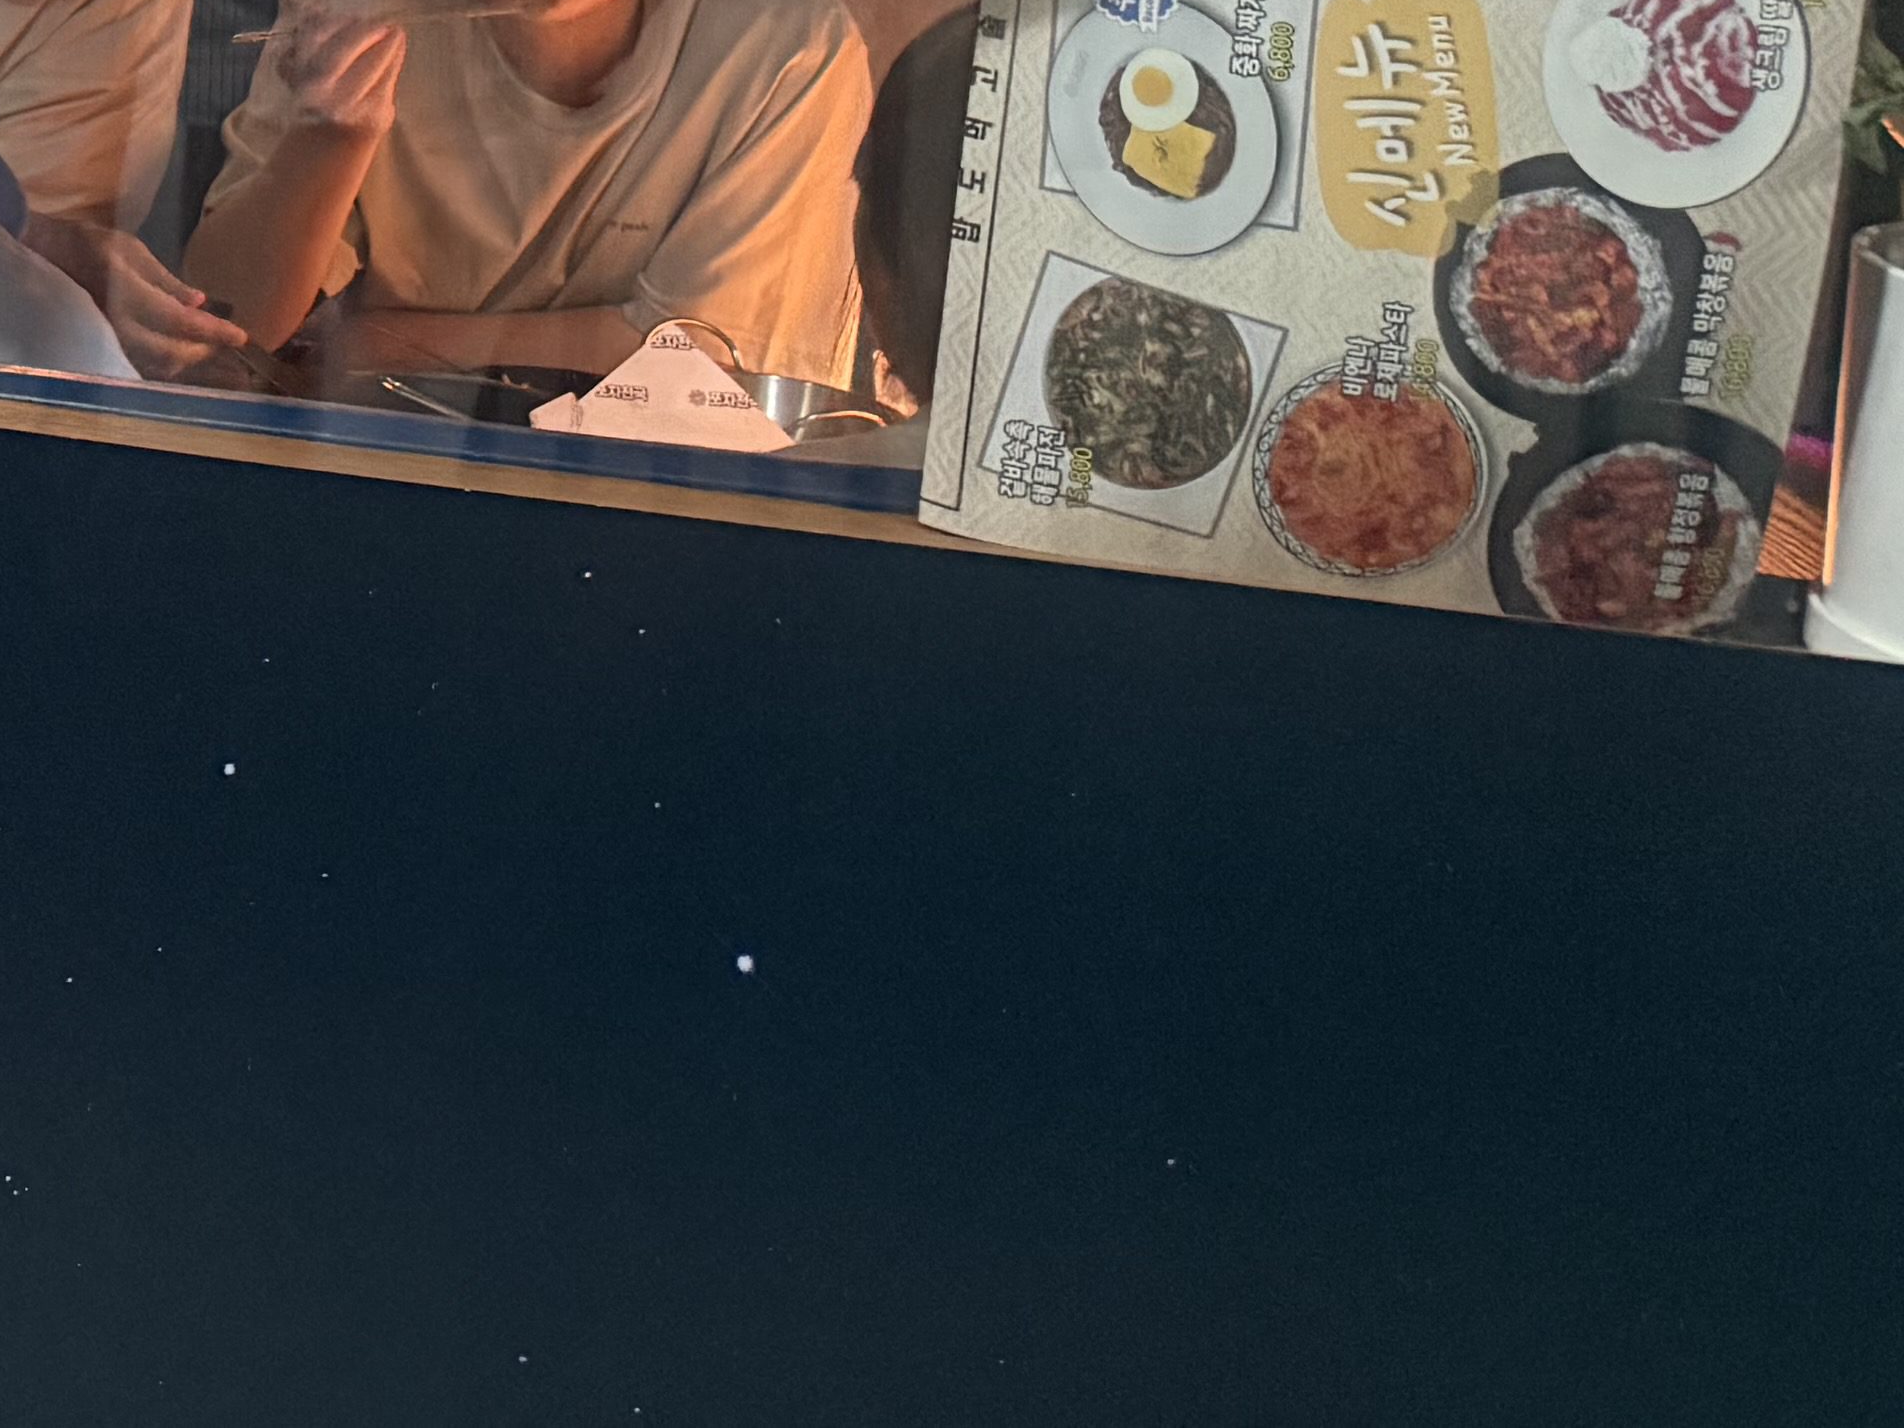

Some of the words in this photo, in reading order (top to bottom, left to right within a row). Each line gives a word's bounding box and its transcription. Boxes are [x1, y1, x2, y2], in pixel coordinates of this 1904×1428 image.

[1229, 35, 1264, 78] 중화
[1268, 22, 1295, 82] 6,800
[1421, 14, 1462, 97] Menu
[1750, 25, 1790, 91] 생크림
[1334, 23, 1440, 227] 신메뉴
[1437, 101, 1478, 165] New
[1691, 252, 1735, 333] 막창볶음
[1341, 336, 1376, 397] 비엔나
[1373, 301, 1414, 403] 로제파스타
[1029, 424, 1067, 505] 해물파전
